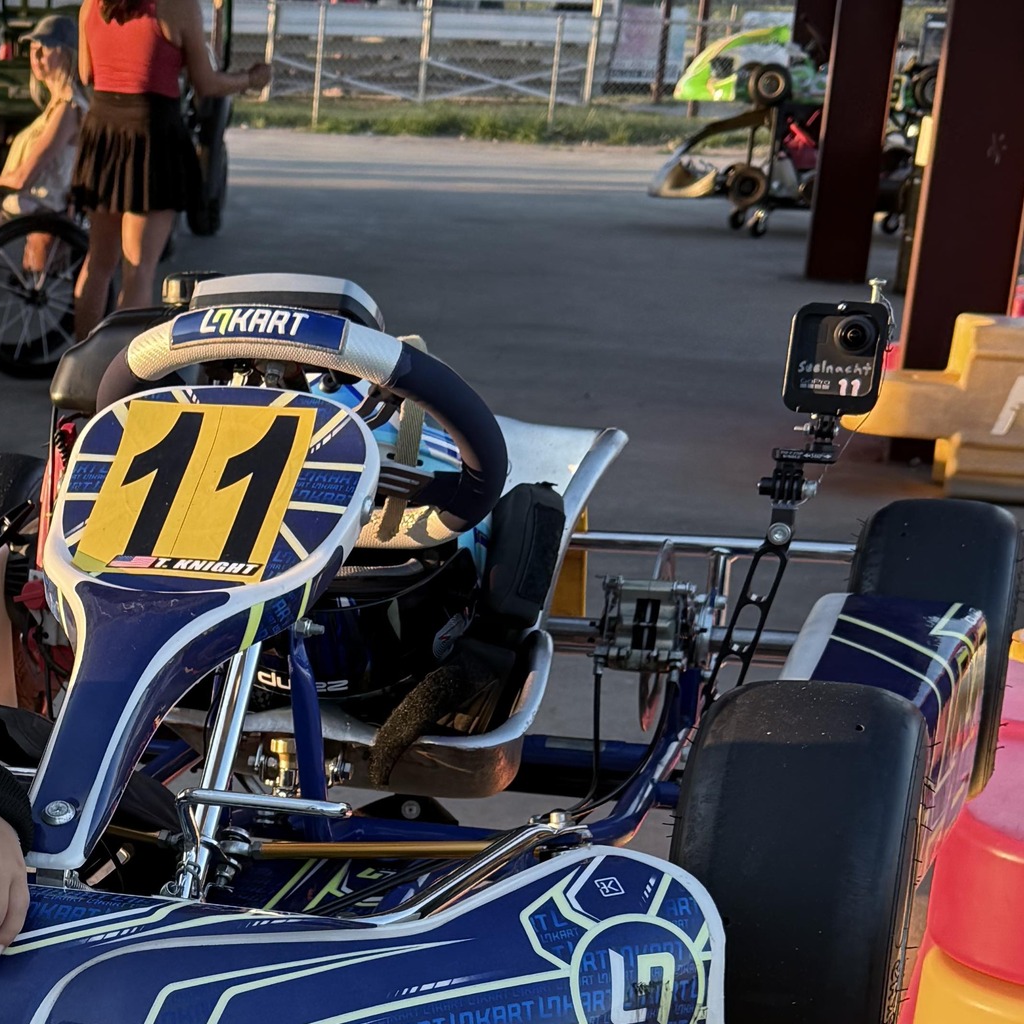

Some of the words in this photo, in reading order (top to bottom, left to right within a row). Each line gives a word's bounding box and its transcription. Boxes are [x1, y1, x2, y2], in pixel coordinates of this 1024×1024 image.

[838, 379, 861, 397] 11
[120, 410, 300, 563] 11
[153, 557, 171, 569] T.
[172, 559, 260, 575] KNIGHT
